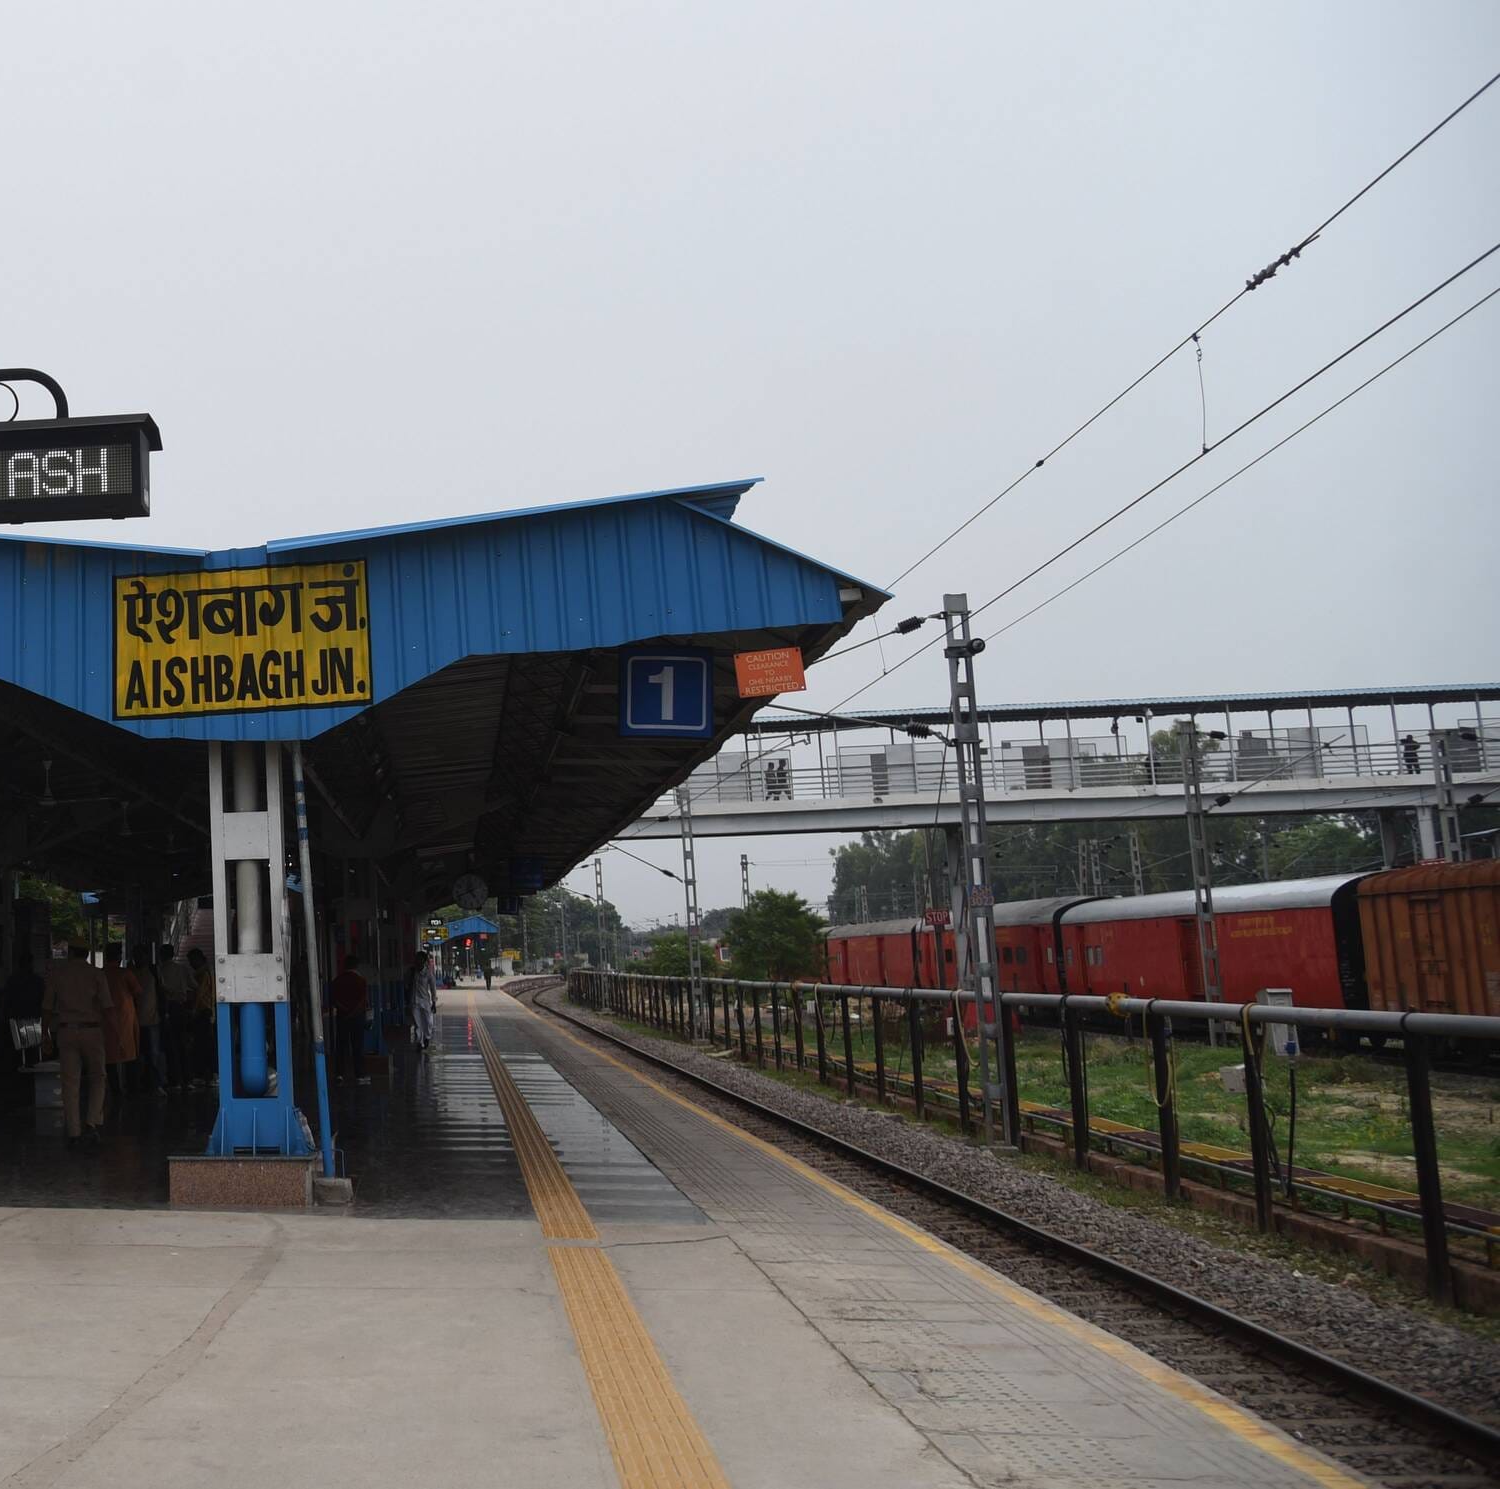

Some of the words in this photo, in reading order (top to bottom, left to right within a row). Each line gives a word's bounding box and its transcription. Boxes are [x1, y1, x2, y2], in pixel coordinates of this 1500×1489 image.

[8, 448, 108, 497] ASH
[123, 580, 304, 644] ऐशबाग
[124, 649, 306, 710] AISHBAGH
[311, 647, 366, 696] JN.
[746, 651, 789, 664] CAUTION
[648, 666, 674, 720] 1
[745, 681, 799, 696] RESTRICTED
[926, 911, 948, 922] STOP
